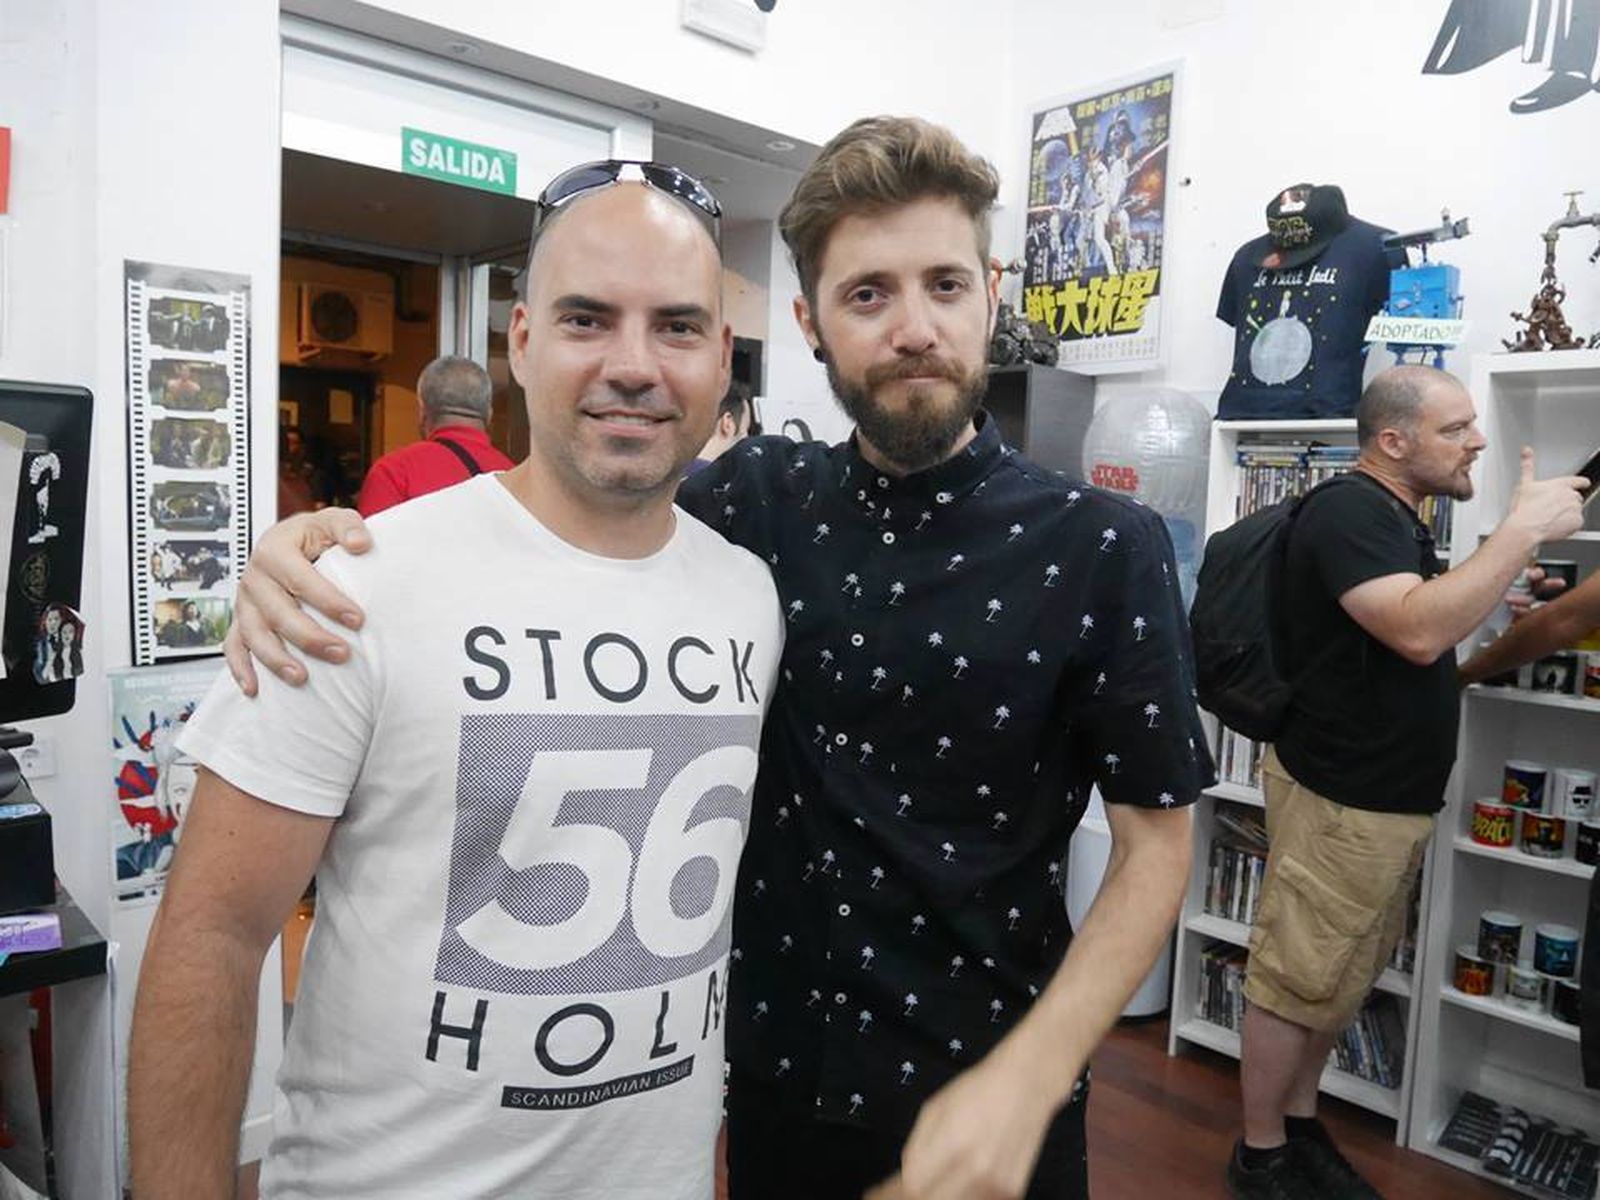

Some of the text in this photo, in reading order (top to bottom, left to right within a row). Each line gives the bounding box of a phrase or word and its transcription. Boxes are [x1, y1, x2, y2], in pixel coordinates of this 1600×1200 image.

[408, 137, 506, 185] SALIDA
[463, 626, 759, 704] STOCK
[455, 745, 758, 972] 56
[510, 1063, 691, 1106] SCANDINAVIAN ISSUE
